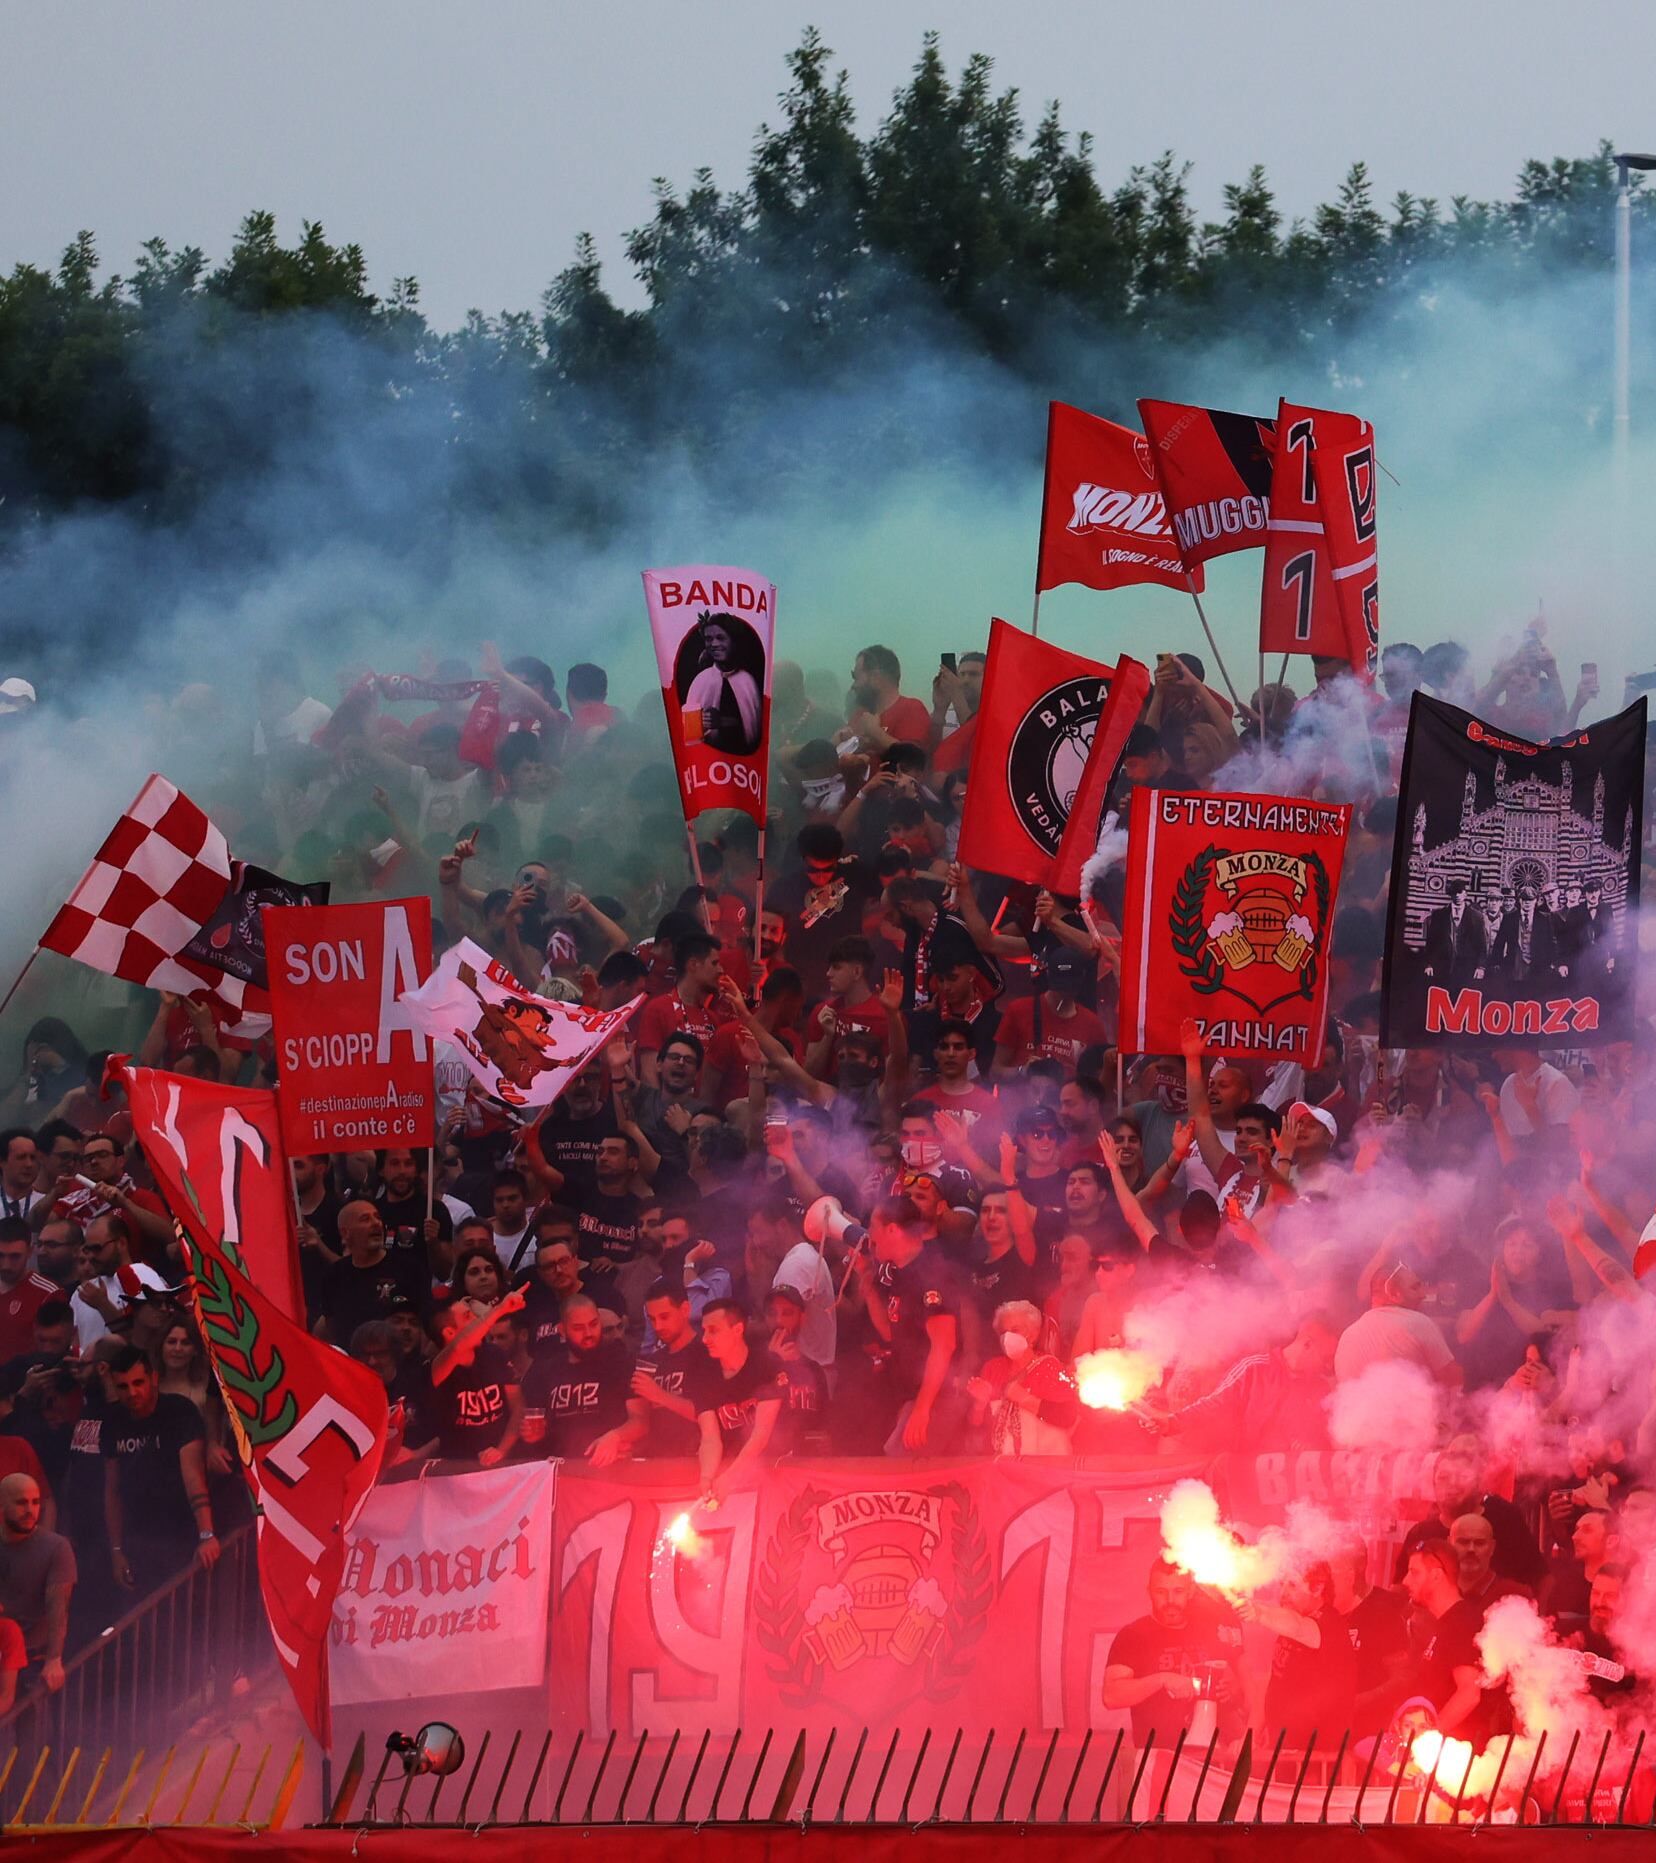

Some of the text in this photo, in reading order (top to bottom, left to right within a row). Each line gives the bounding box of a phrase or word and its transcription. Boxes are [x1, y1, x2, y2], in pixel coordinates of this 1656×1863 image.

[1067, 483, 1173, 536] MONZ
[1108, 549, 1145, 565] SOGNO
[1157, 558, 1194, 574] REAL
[660, 580, 768, 614] BANDA
[1227, 855, 1300, 878] MONZA
[285, 939, 366, 985] SON
[1425, 985, 1600, 1035] Monza
[313, 1113, 416, 1140] il conte c'è
[457, 1384, 503, 1416] 1912
[551, 1382, 600, 1409] 1912
[832, 1493, 931, 1528] MONZA
[370, 1601, 502, 1649] Monza
